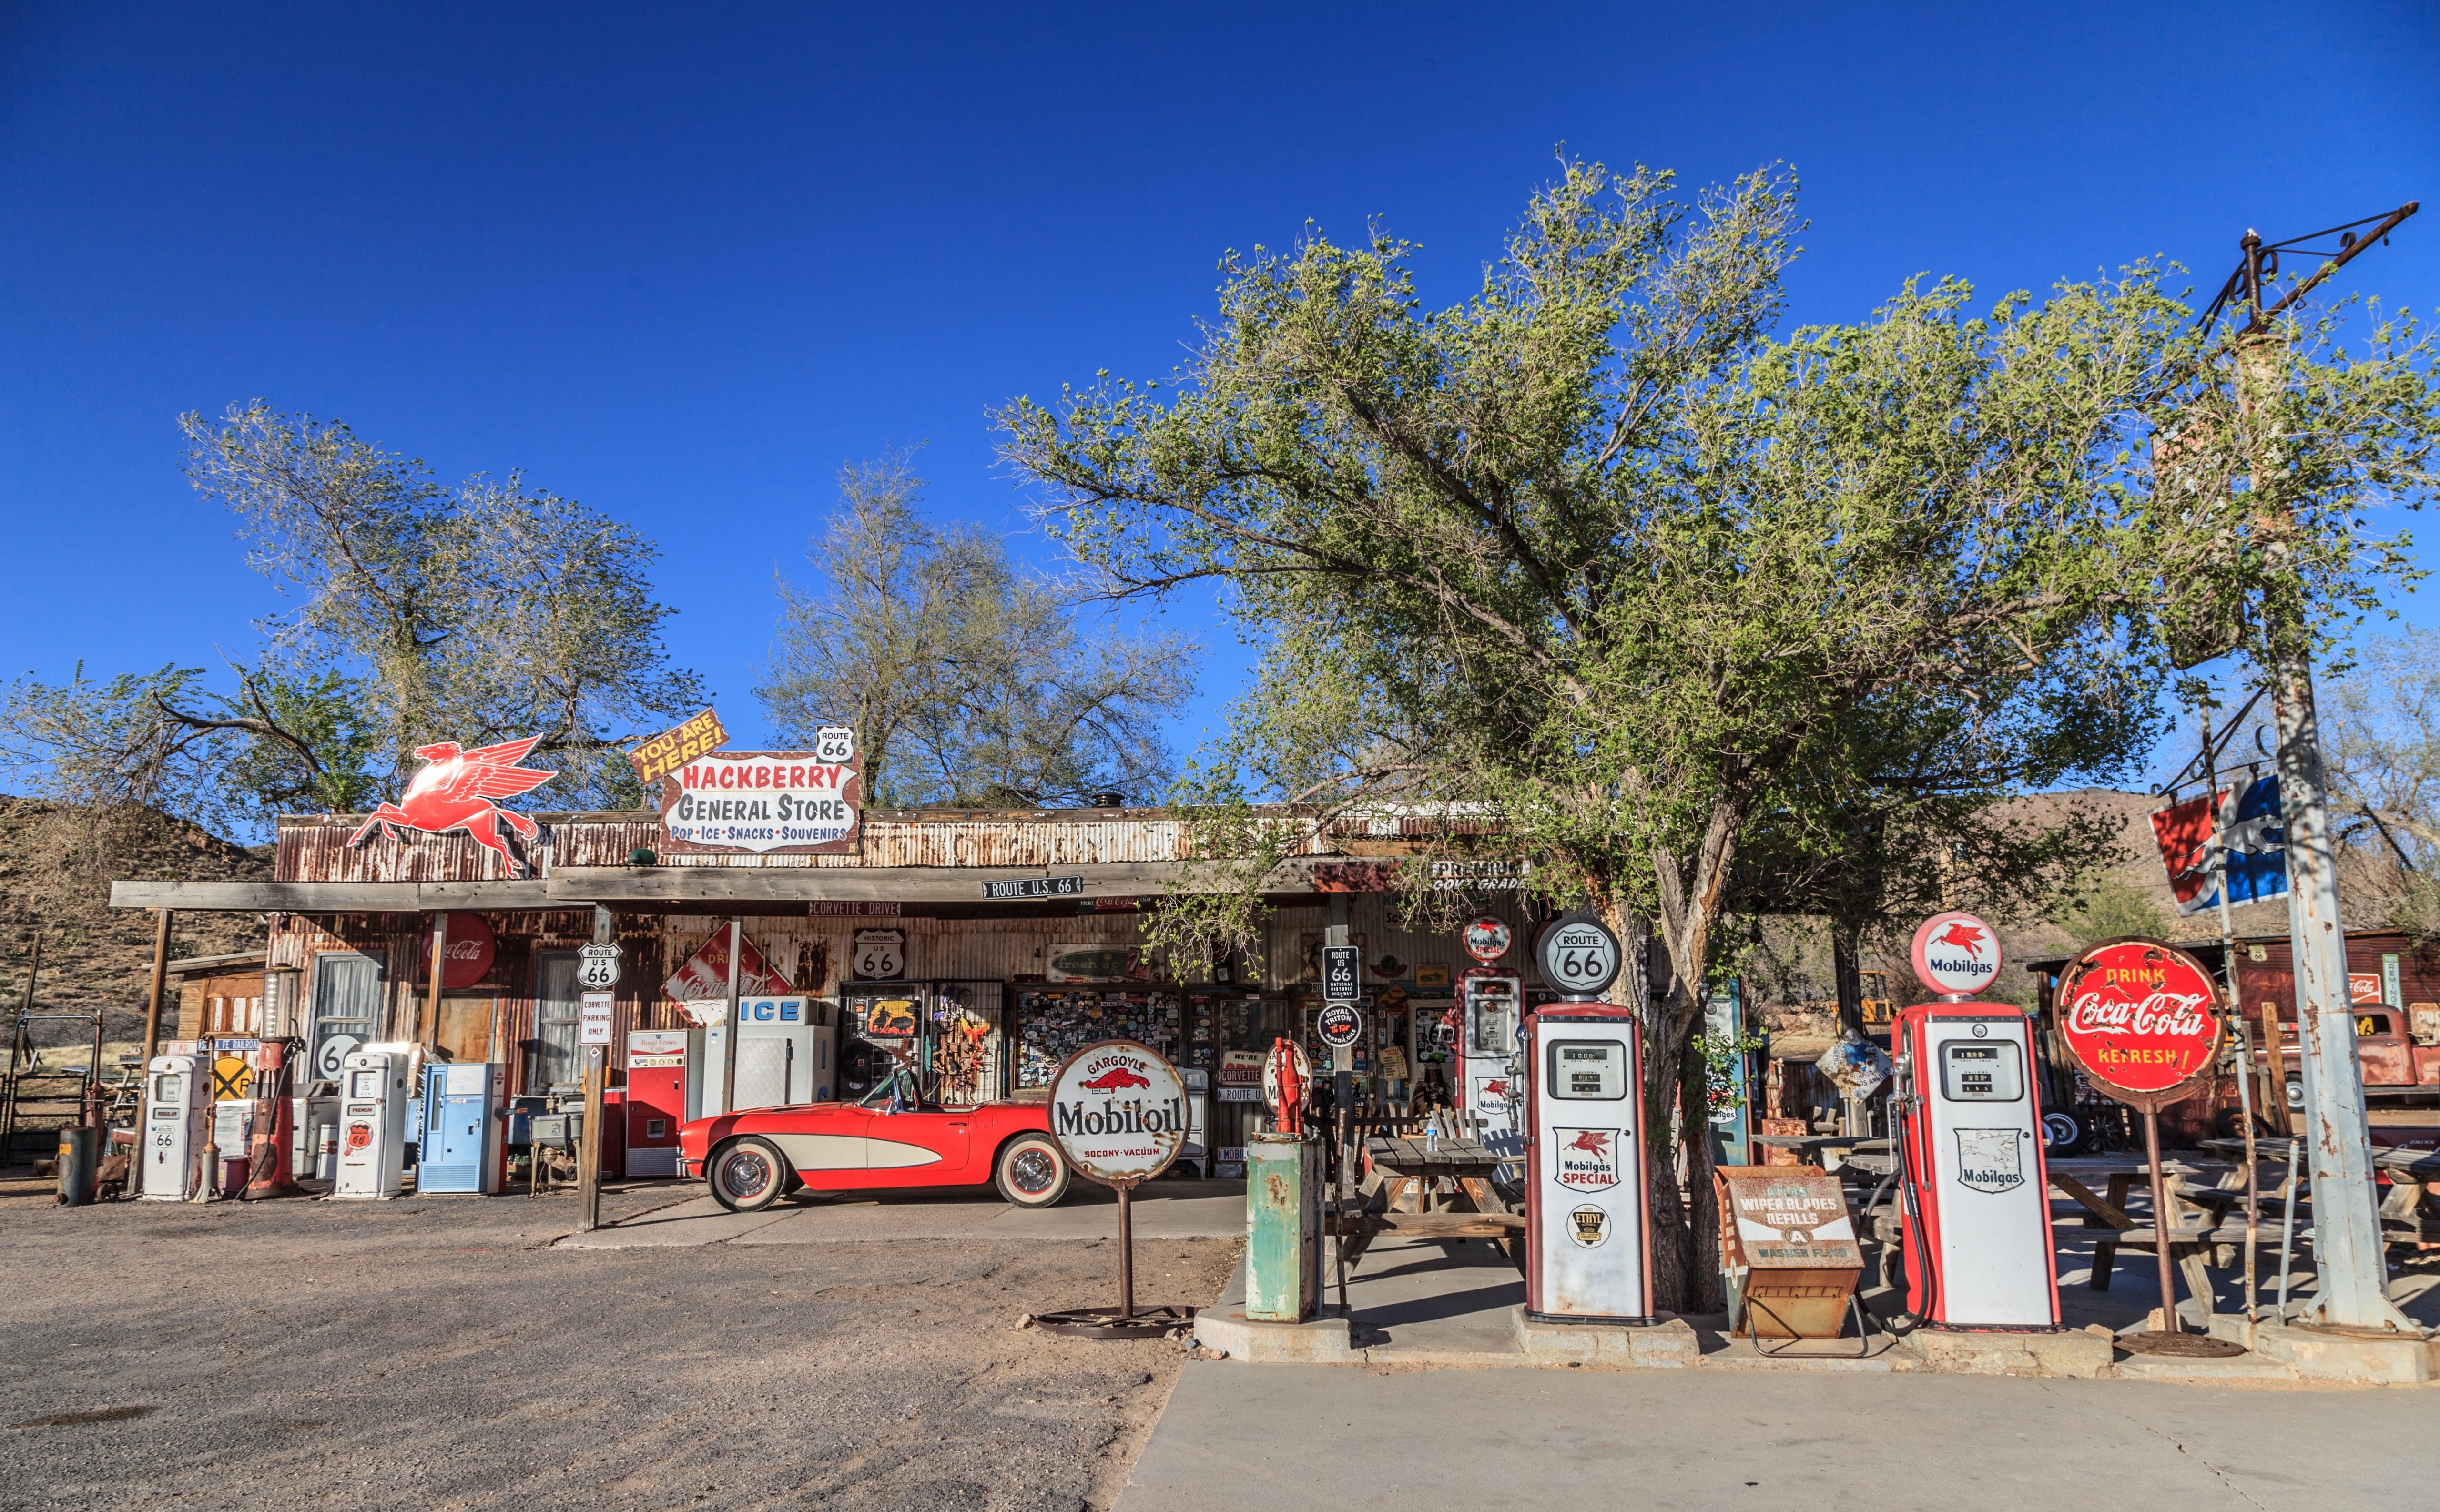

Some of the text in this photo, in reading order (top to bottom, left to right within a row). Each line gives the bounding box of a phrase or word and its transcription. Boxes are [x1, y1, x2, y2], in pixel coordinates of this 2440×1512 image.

[635, 714, 714, 763] YOU ARE
[643, 727, 722, 781] HERE!
[823, 741, 847, 756] 66
[684, 765, 841, 790] HACKBERRY
[678, 793, 844, 821] GENERAL STORE
[671, 826, 846, 840] POP ICE SNACKS SOUVENIRS
[992, 879, 1071, 897] ROUTE U.S. 66
[813, 902, 895, 915] CORVETTE DRIVE
[1470, 937, 1505, 947] Mobilgas
[1564, 936, 1599, 945] ROUTE
[708, 954, 746, 964] DRIK
[864, 953, 893, 972] 66
[1564, 950, 1602, 977] 66
[1930, 958, 1993, 976] Mobilgas
[588, 967, 609, 983] 66
[1332, 968, 1351, 981] 66
[2106, 968, 2166, 983] DRINK
[741, 1001, 800, 1021] ICE
[1326, 1009, 1349, 1018] ROYAL
[2068, 991, 2208, 1036] Coca-Cola
[1325, 1015, 1352, 1025] TRITON
[1325, 1029, 1356, 1043] MOTOR OILS
[1088, 1055, 1145, 1075] GARGOYLE
[1222, 1071, 1260, 1081] CORVETTE
[1869, 1067, 1890, 1085] ANGELES
[1227, 1090, 1250, 1100] ROUTE
[1057, 1096, 1183, 1136] Mobiloil
[157, 1134, 172, 1146] 66
[353, 1135, 365, 1144] 66
[1224, 1149, 1246, 1159] MOBIL
[1564, 1160, 1611, 1172] Mobilgas
[1563, 1173, 1614, 1184] SPECIAL
[1963, 1169, 2020, 1187] Mobilgas
[1766, 1187, 1808, 1197] ATLAS
[1740, 1198, 1837, 1210] WIPER BLADES
[1576, 1214, 1602, 1223] ETHYL
[1767, 1213, 1819, 1225] REFILLS
[1758, 1248, 1847, 1257] WASHER FLUID
